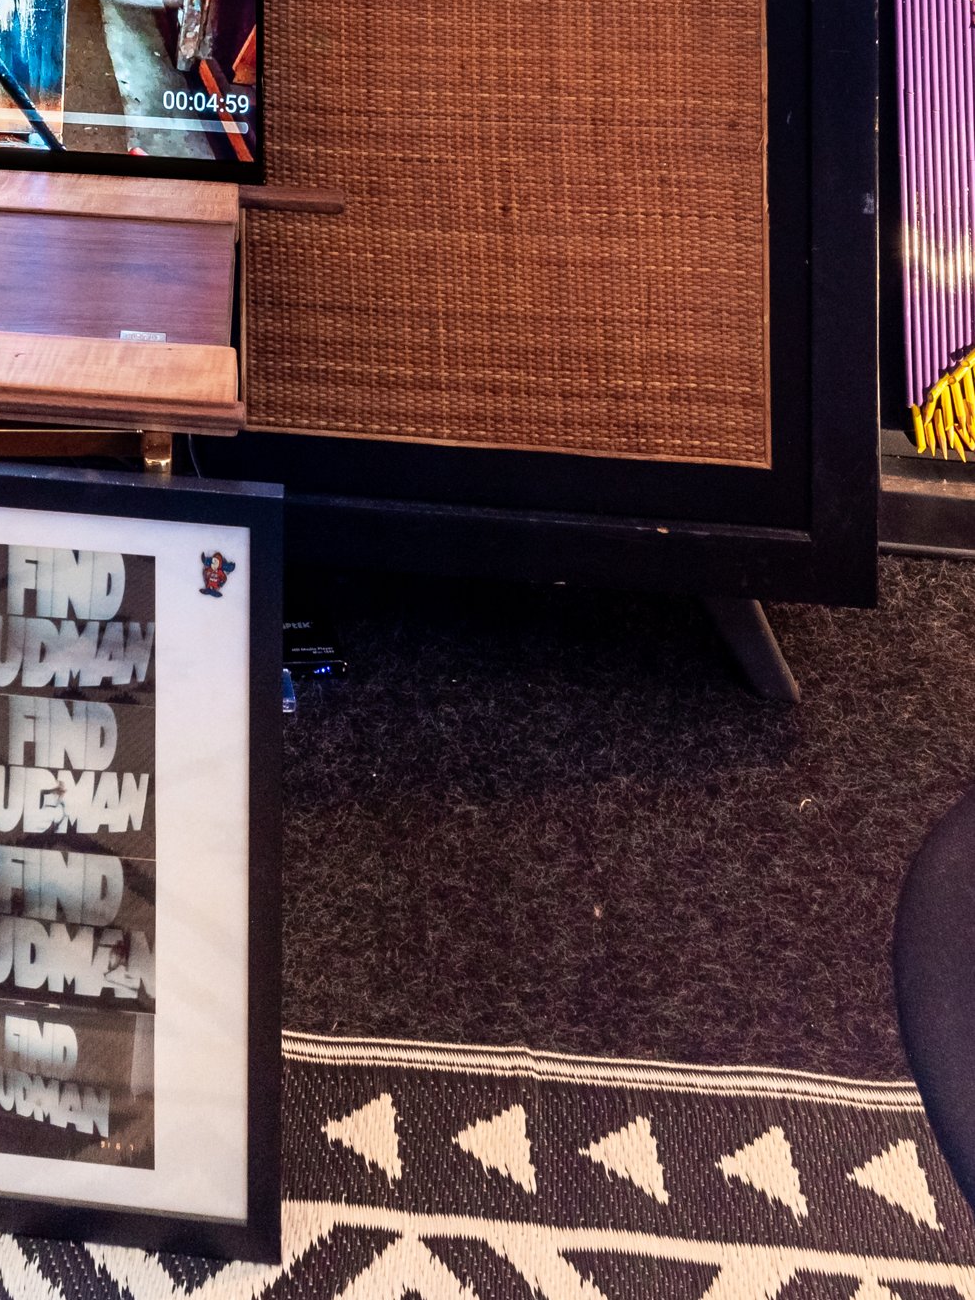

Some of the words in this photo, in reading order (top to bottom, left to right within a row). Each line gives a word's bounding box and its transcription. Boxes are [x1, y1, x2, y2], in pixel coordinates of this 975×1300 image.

[162, 90, 250, 114] 00:04:59
[7, 544, 125, 620] FIND
[8, 696, 118, 771] FIND
[4, 1015, 78, 1074] FIND
